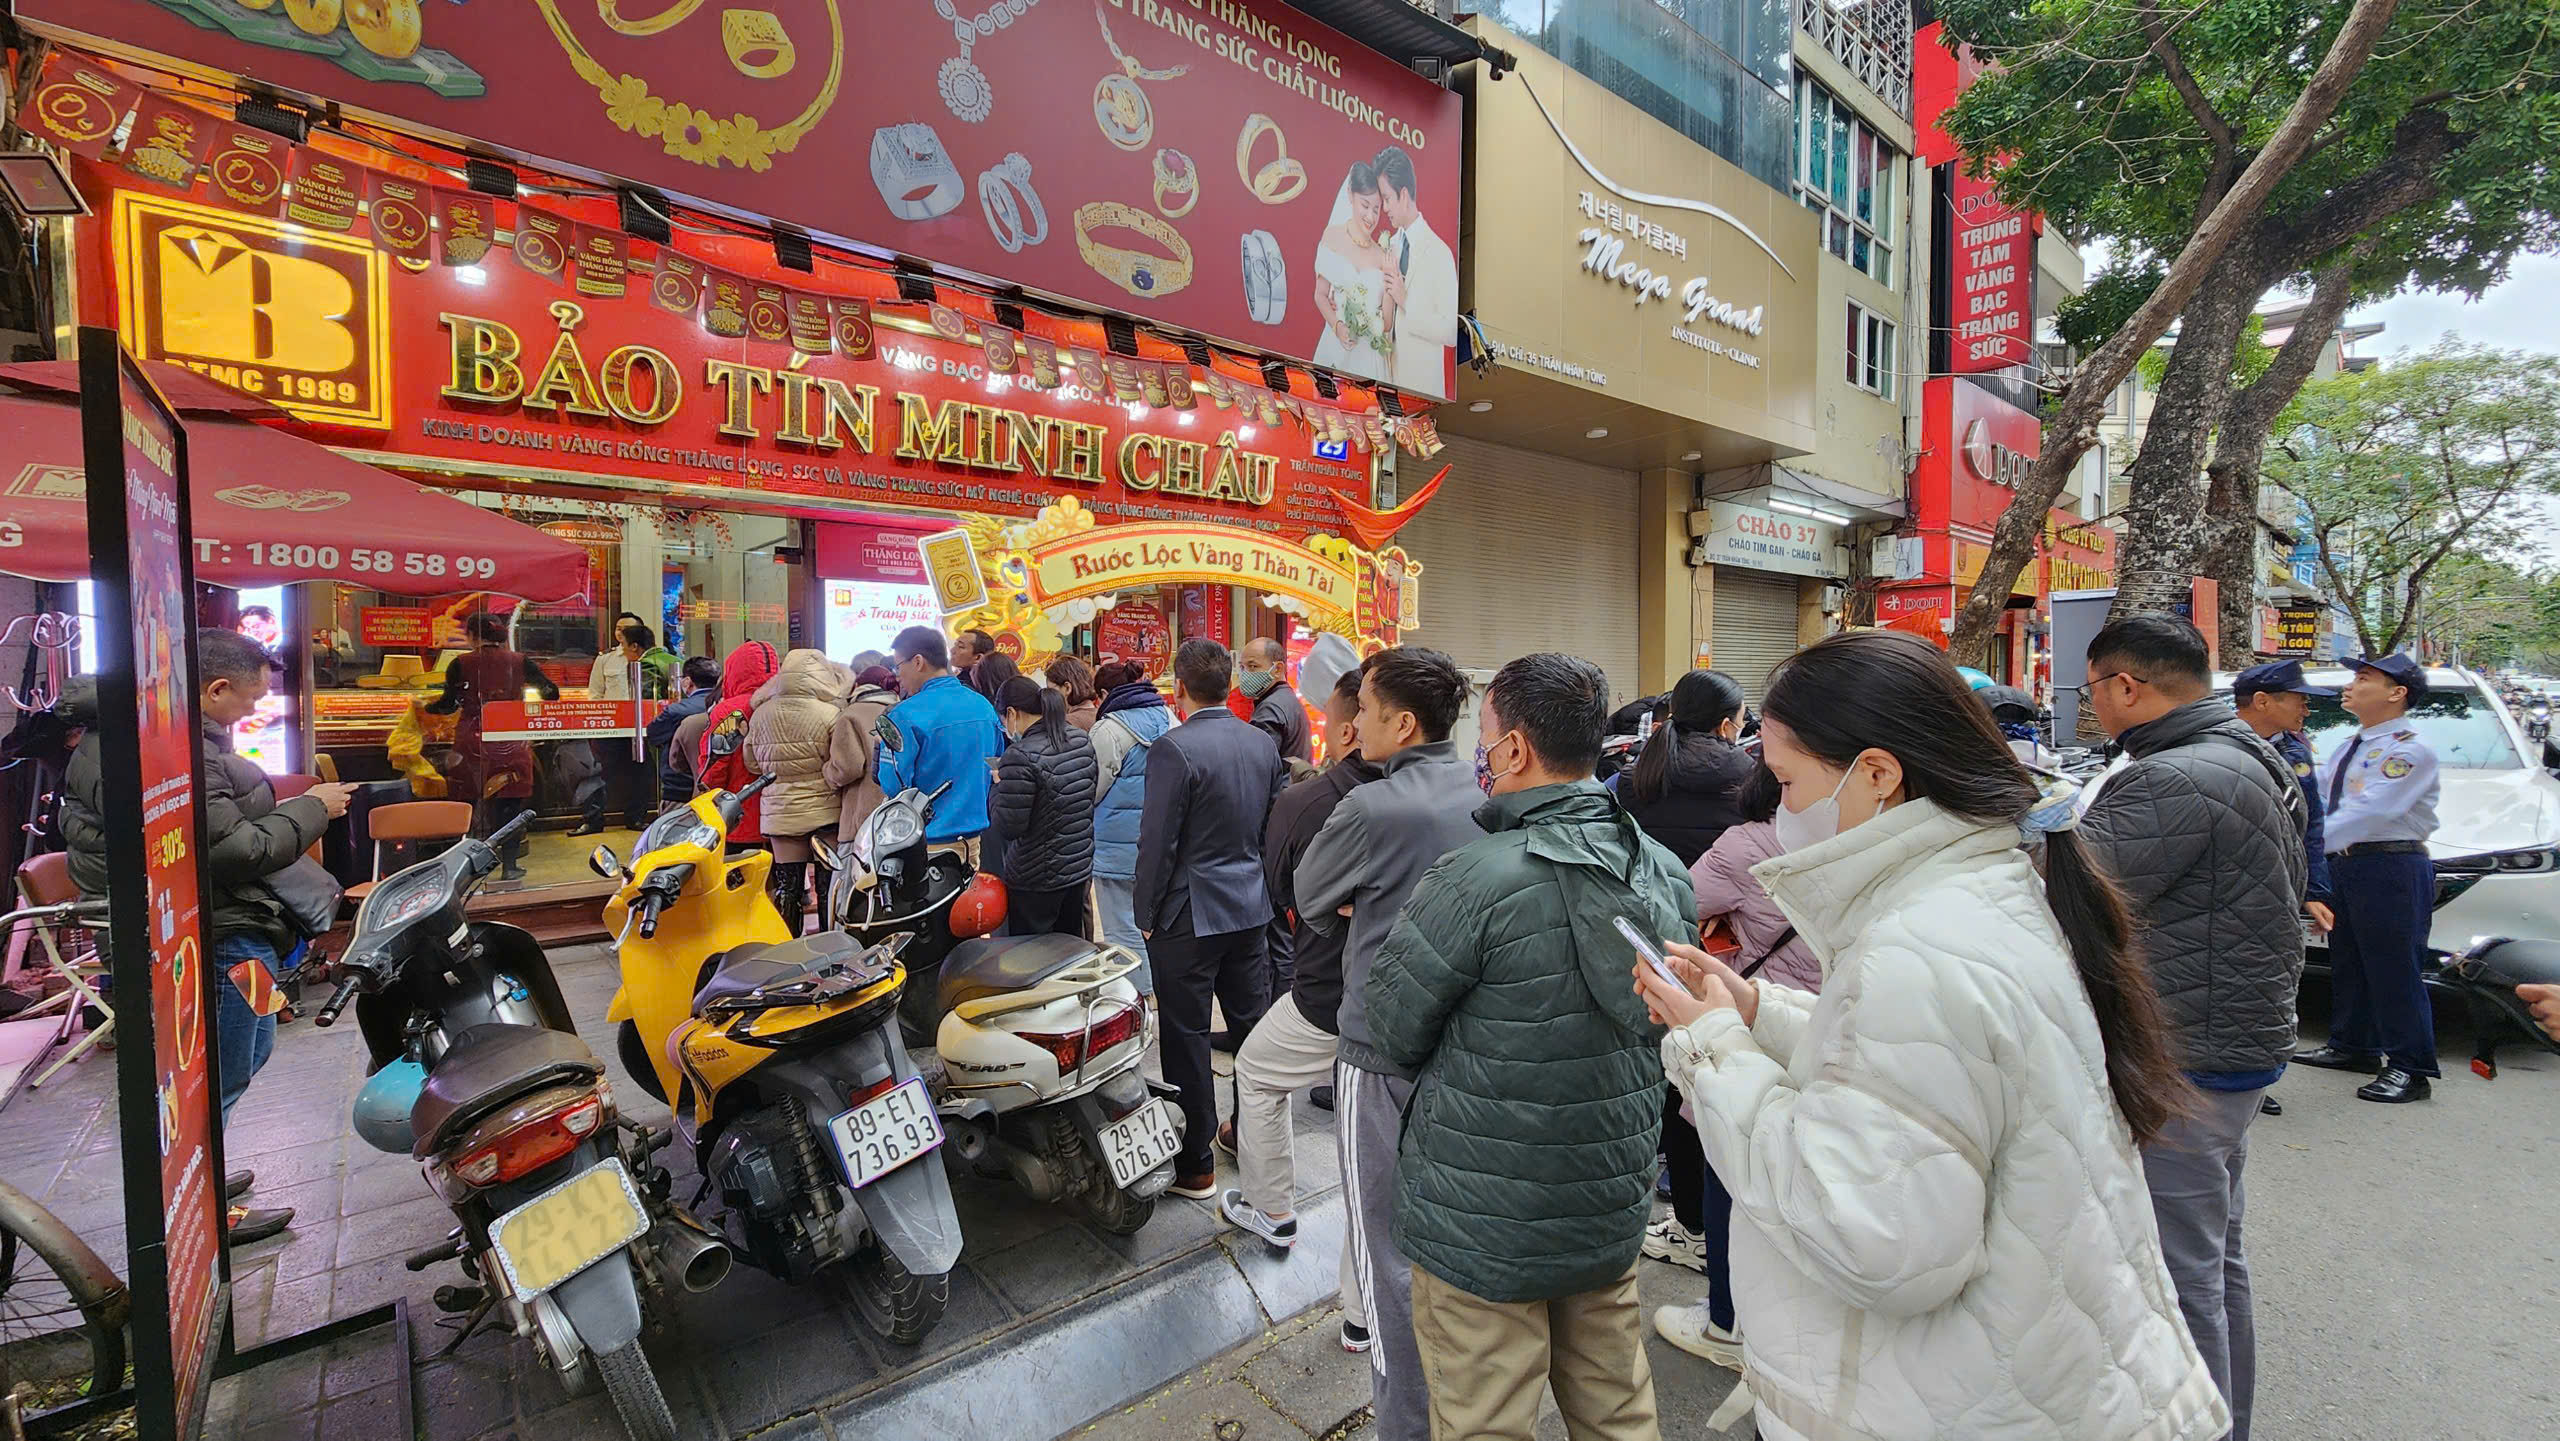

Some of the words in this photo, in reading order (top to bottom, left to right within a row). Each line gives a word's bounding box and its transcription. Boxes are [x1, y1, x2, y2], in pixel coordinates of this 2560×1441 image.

[1287, 32, 1341, 78] LONG
[1215, 33, 1259, 72] SỨC
[1263, 62, 1317, 100] CHẤT
[1320, 83, 1385, 133] LƯỢNG
[1387, 117, 1425, 150] CAO
[1960, 216, 2022, 249] TRUNG
[1970, 242, 2010, 269] TÂM
[1578, 228, 1672, 305] Mega
[1682, 277, 1764, 335] Grand
[1965, 265, 2015, 293] VÀNG
[1969, 289, 2008, 317] BẠC
[1959, 311, 2020, 340] TRANG
[439, 300, 683, 424] BẢO
[1527, 352, 1537, 364] 35
[1672, 326, 1723, 354] INSTITUTE
[1728, 347, 1761, 369] CLINIC
[1969, 336, 2008, 361] SỨC
[881, 346, 937, 372] VÀNG
[942, 360, 983, 382] BẠC
[279, 374, 357, 404] 1989
[706, 352, 880, 453] TÍN
[896, 391, 1108, 483] MINH
[1117, 431, 1280, 506] CHÂU
[422, 418, 474, 440] KINH
[478, 426, 553, 450] DOANH
[558, 433, 612, 457] VÀNG
[616, 439, 670, 464] RỒNG
[674, 449, 735, 471] THĂNG
[737, 457, 788, 480] LONG,
[792, 464, 821, 482] SJC
[823, 464, 844, 485] VÀ
[848, 469, 888, 489] VÀNG
[889, 477, 937, 495] TRANG
[937, 481, 964, 498] SỨC
[966, 484, 986, 500] MỸ
[988, 489, 1022, 508] NGHỆ
[1340, 467, 1363, 481] TÔNG
[567, 528, 581, 538] SỨC
[1736, 514, 1792, 541] CHÁO
[1796, 527, 1817, 545] 37
[246, 541, 340, 569] 1800
[350, 549, 394, 573] 58
[403, 552, 446, 576] 58
[455, 556, 496, 579] 99
[864, 545, 901, 560] THĂNG
[902, 549, 923, 562] LON
[1728, 537, 1751, 551] CHÁO
[1752, 542, 1767, 554] TIM
[1769, 545, 1785, 557] GAN
[1791, 548, 1810, 562] CHÁO
[1071, 546, 1135, 580] Rước
[1140, 541, 1182, 568] Lộc
[1188, 541, 1244, 572] Vàng
[1249, 549, 1300, 581] Thần
[1307, 566, 1335, 595] Tài
[857, 610, 867, 618] &
[869, 607, 908, 622] Trang
[910, 610, 932, 620] sức
[895, 593, 931, 607] Nhẫn
[1214, 609, 1223, 639] BTMC
[996, 641, 1018, 655] Đón
[528, 721, 562, 729] 09:00
[582, 720, 616, 728] 19:00
[161, 826, 186, 869] 30%
[960, 1062, 1009, 1073] LEAD
[846, 1089, 916, 1143] 89-E1
[1110, 1106, 1157, 1153] 29-Y7
[847, 1115, 937, 1181] 736.93
[1115, 1129, 1176, 1181] 076.16
